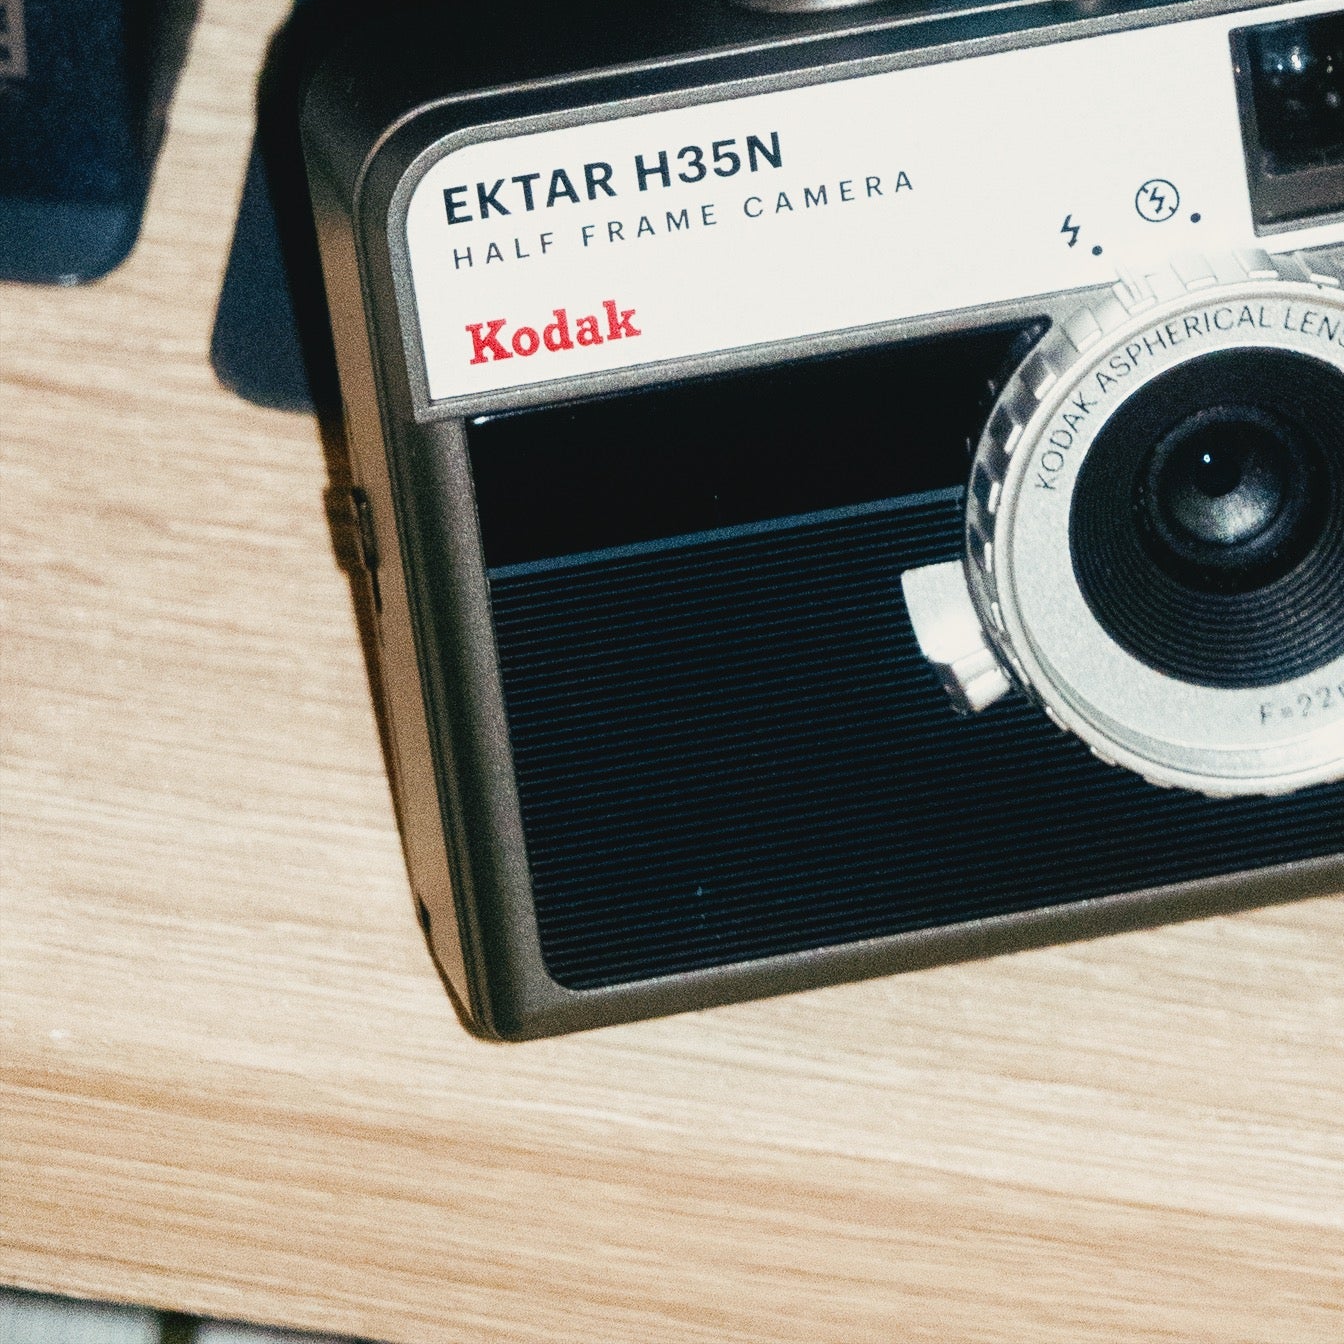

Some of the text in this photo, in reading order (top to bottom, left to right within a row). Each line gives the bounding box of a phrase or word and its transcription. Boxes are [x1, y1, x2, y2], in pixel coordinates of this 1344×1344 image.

[443, 131, 784, 226] EKTAR H35N
[453, 170, 914, 270] HALF FRAME CAMERA
[465, 300, 641, 365] Kodak
[1034, 391, 1098, 491] KODAK
[1096, 305, 1271, 393] ASPHERICAL
